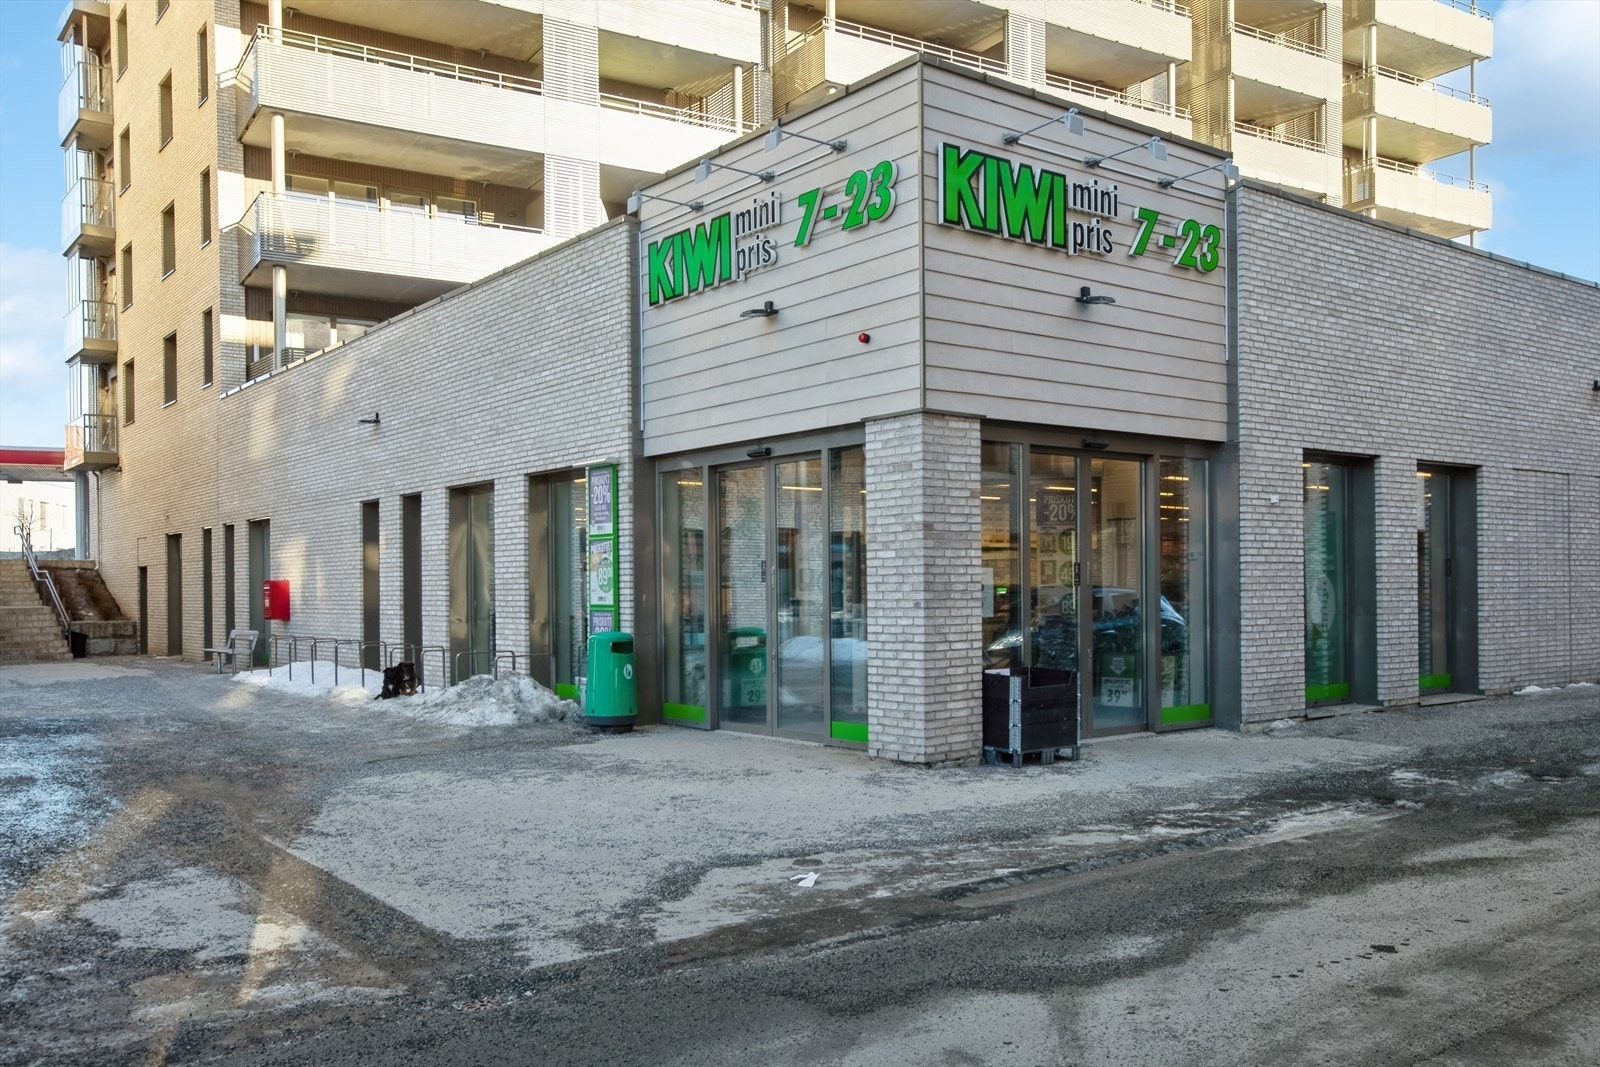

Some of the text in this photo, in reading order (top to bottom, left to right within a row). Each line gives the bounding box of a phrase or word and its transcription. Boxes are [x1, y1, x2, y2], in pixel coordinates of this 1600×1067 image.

[735, 191, 777, 237] mini
[941, 142, 1067, 250] KIWI
[1072, 179, 1117, 217] mini
[647, 211, 733, 307] KIWI
[736, 234, 774, 280] pris
[1072, 219, 1113, 255] pris
[591, 485, 611, 505] -20%
